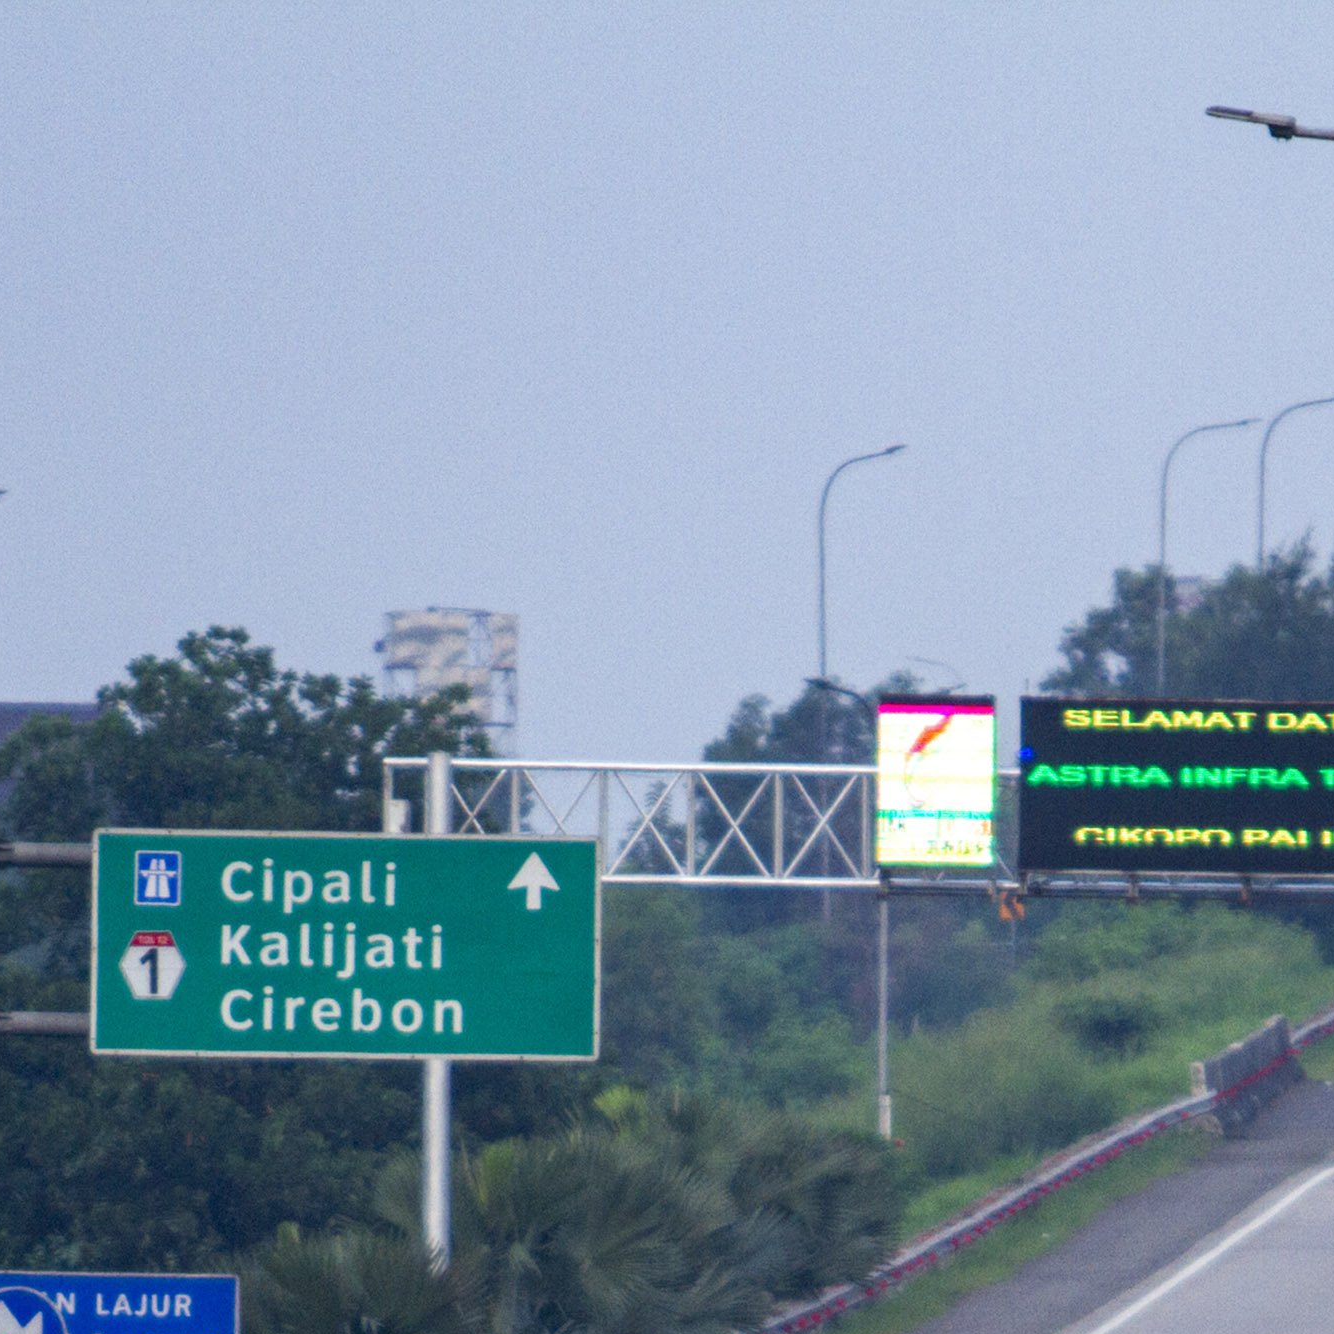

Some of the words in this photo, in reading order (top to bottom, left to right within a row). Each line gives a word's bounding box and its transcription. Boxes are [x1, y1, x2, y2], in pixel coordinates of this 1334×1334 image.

[1063, 709, 1258, 732] SELAMAT
[1027, 764, 1172, 788] ASTRA
[1180, 767, 1310, 790] INFRA
[221, 858, 397, 914] Cipali
[139, 947, 159, 995] 1
[220, 922, 444, 980] Kalijati
[220, 986, 464, 1034] Cirebon
[95, 1292, 193, 1318] LAJUR
